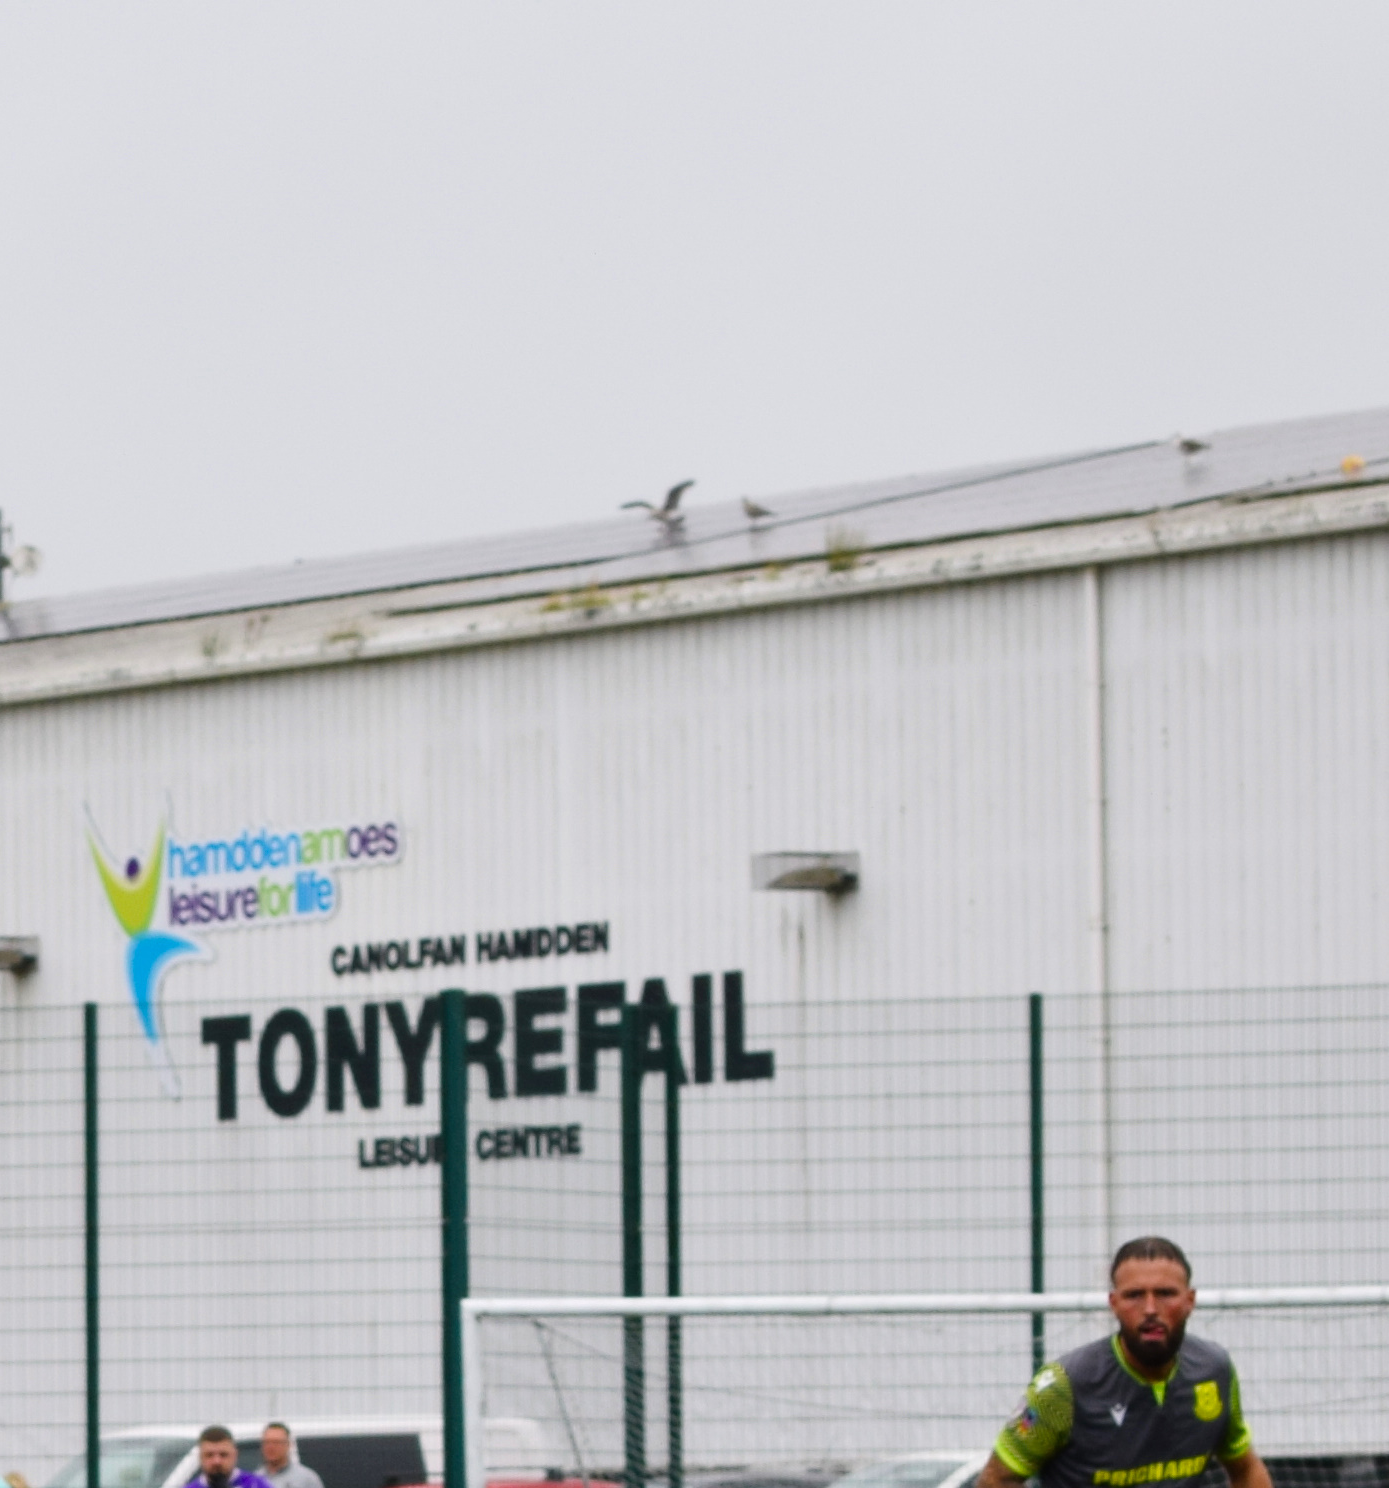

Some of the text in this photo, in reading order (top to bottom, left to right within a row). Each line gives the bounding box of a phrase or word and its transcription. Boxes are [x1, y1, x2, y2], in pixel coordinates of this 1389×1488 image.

[331, 920, 609, 975] CANOLFAN HAMDDEN
[202, 971, 774, 1121] TONYREFAIL
[476, 1123, 582, 1161] CENTRE
